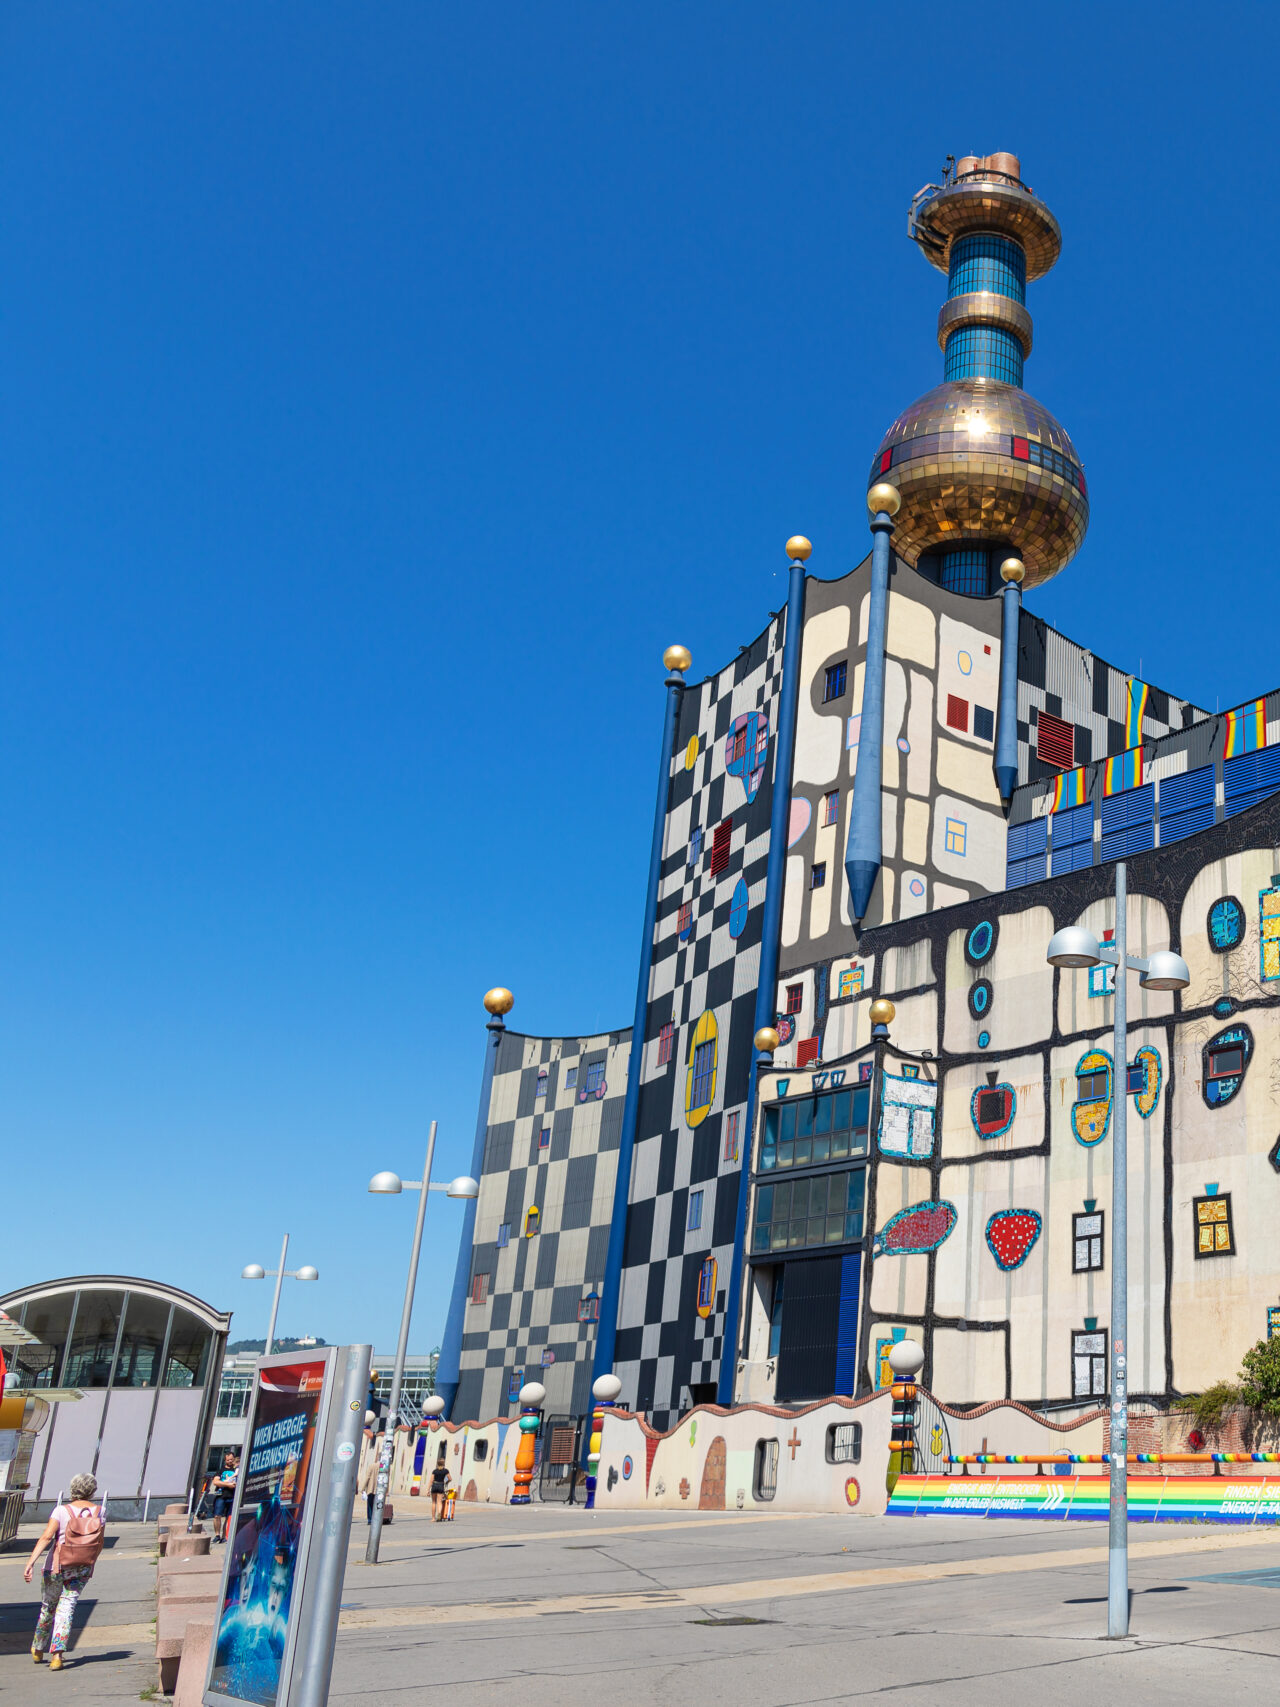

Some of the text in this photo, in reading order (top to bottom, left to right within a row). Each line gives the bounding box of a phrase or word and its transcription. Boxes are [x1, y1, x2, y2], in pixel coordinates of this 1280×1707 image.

[253, 1413, 308, 1449] WIEN ENERGIE-
[249, 1439, 304, 1473] ERLEBNISWELT.
[995, 1483, 1042, 1496] ENTDECKEN
[1223, 1485, 1261, 1499] FINDEN
[941, 1497, 953, 1508] IN
[951, 1497, 968, 1508] DER
